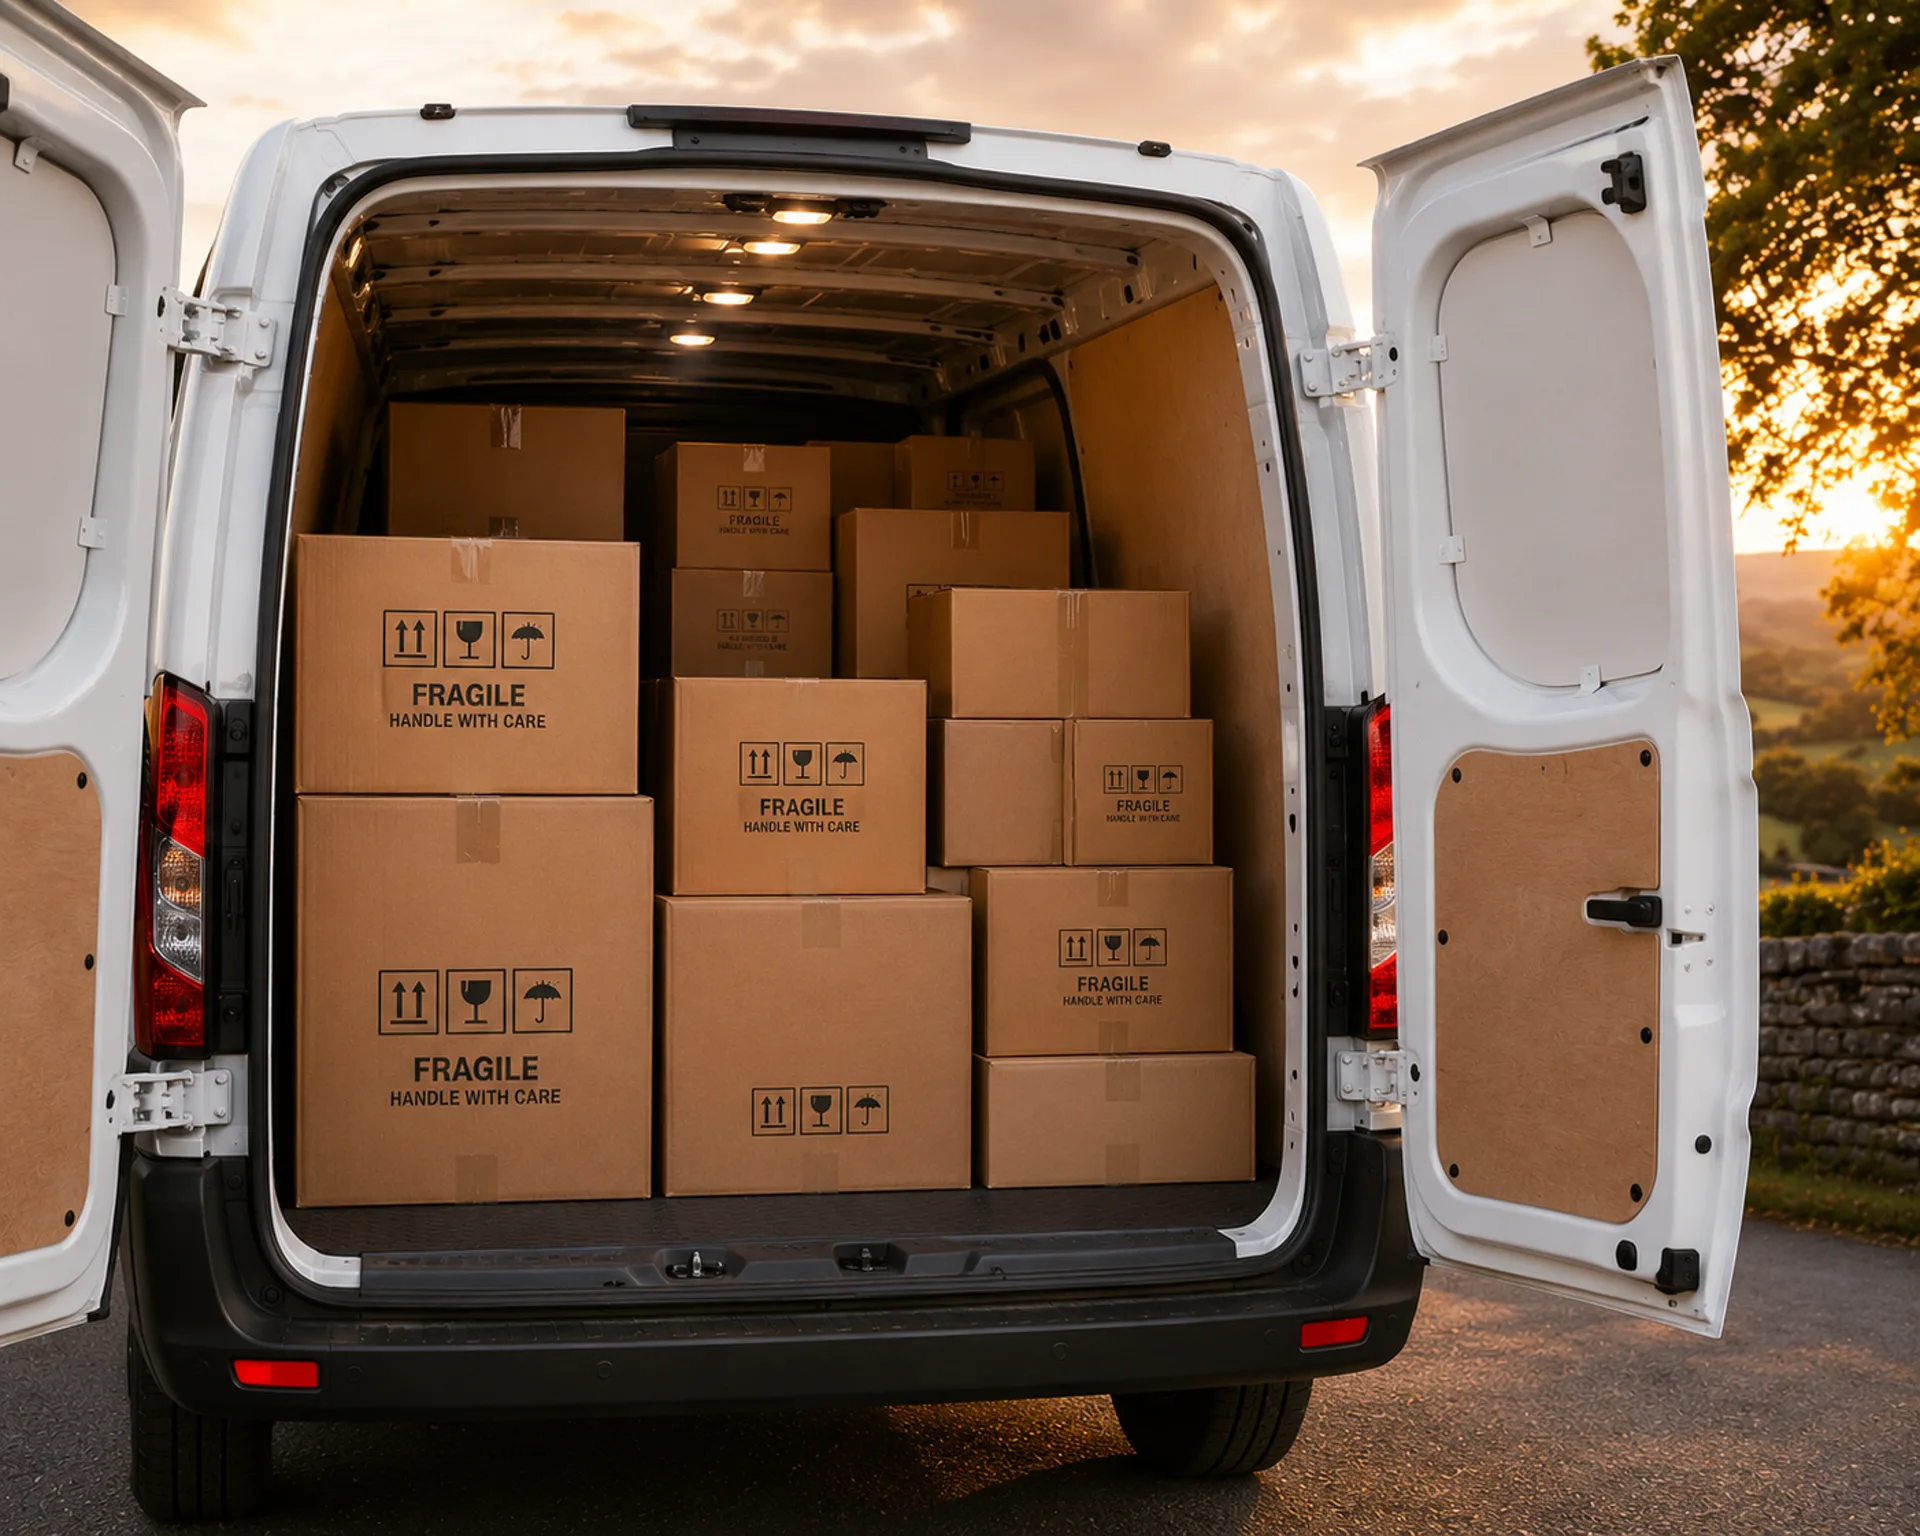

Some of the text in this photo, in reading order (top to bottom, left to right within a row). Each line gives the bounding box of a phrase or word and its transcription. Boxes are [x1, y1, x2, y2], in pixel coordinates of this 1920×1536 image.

[412, 683, 525, 707] FRAGILE
[389, 713, 546, 728] HANDLE WITH CARE
[760, 798, 844, 816] FRAGILE
[1117, 799, 1170, 812] FRAGILE
[744, 821, 860, 833] HANDLE WITH CARE
[1077, 976, 1149, 992] FRAGILE
[1063, 994, 1162, 1006] HANDLE WITH CARE
[414, 1055, 538, 1082] FRAGILE
[390, 1088, 561, 1107] HANDLE WITH CARE
